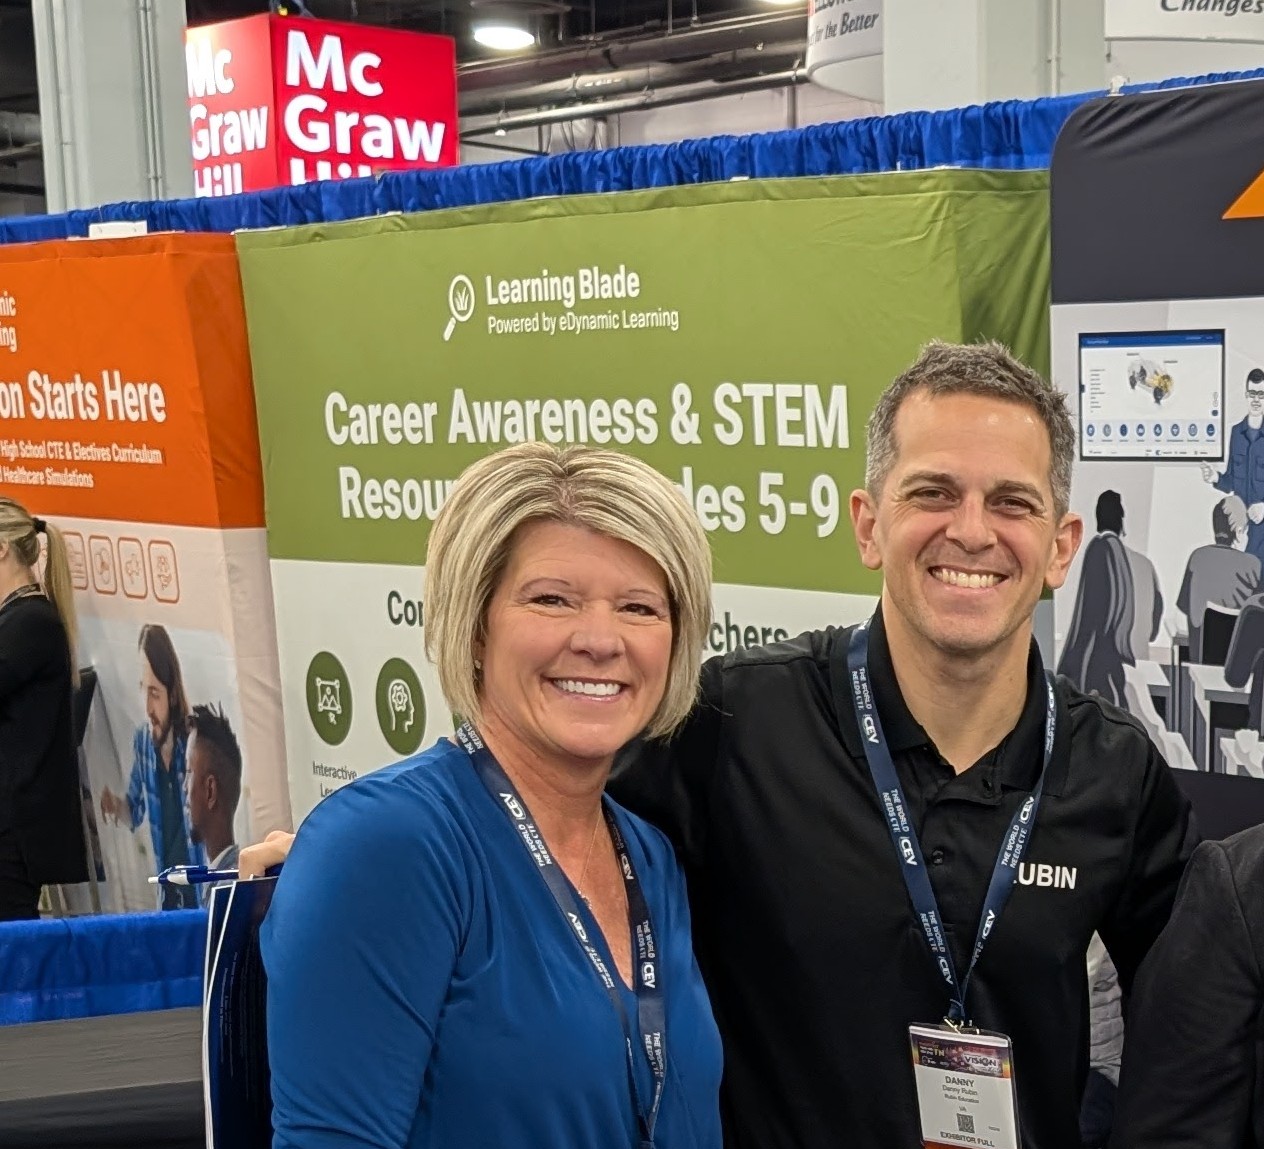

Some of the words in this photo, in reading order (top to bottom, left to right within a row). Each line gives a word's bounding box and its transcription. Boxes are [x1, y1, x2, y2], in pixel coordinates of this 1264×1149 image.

[840, 11, 879, 36] Better
[286, 30, 383, 97] Mc
[190, 104, 268, 160] Graw
[284, 94, 446, 163] Graw
[486, 269, 575, 308] Learning
[578, 264, 640, 300] Blade
[488, 313, 538, 334] Powered
[542, 312, 557, 335] by
[559, 310, 619, 334] eDynamic
[622, 308, 679, 331] Learning
[28, 370, 99, 420] Starts
[102, 369, 166, 422] Here
[324, 391, 438, 447] Career
[448, 388, 658, 445] Awareness
[670, 383, 701, 445] &
[713, 383, 849, 449] STEM
[19, 439, 46, 458] School
[47, 441, 63, 459] CTE
[65, 442, 72, 460] &
[72, 442, 111, 461] Electives
[111, 442, 163, 464] Curriculum
[45, 467, 94, 488] Simulations
[759, 472, 840, 538] 5-9
[709, 611, 789, 651] chers
[1001, 852, 1011, 866] THE
[1006, 825, 1019, 851] WORLD
[1010, 844, 1022, 868] NEEDS
[1013, 862, 1077, 890] UBIN
[945, 1076, 975, 1088] DANNY
[940, 1131, 976, 1144] EXHIBITOR
[977, 1137, 995, 1148] FULL
